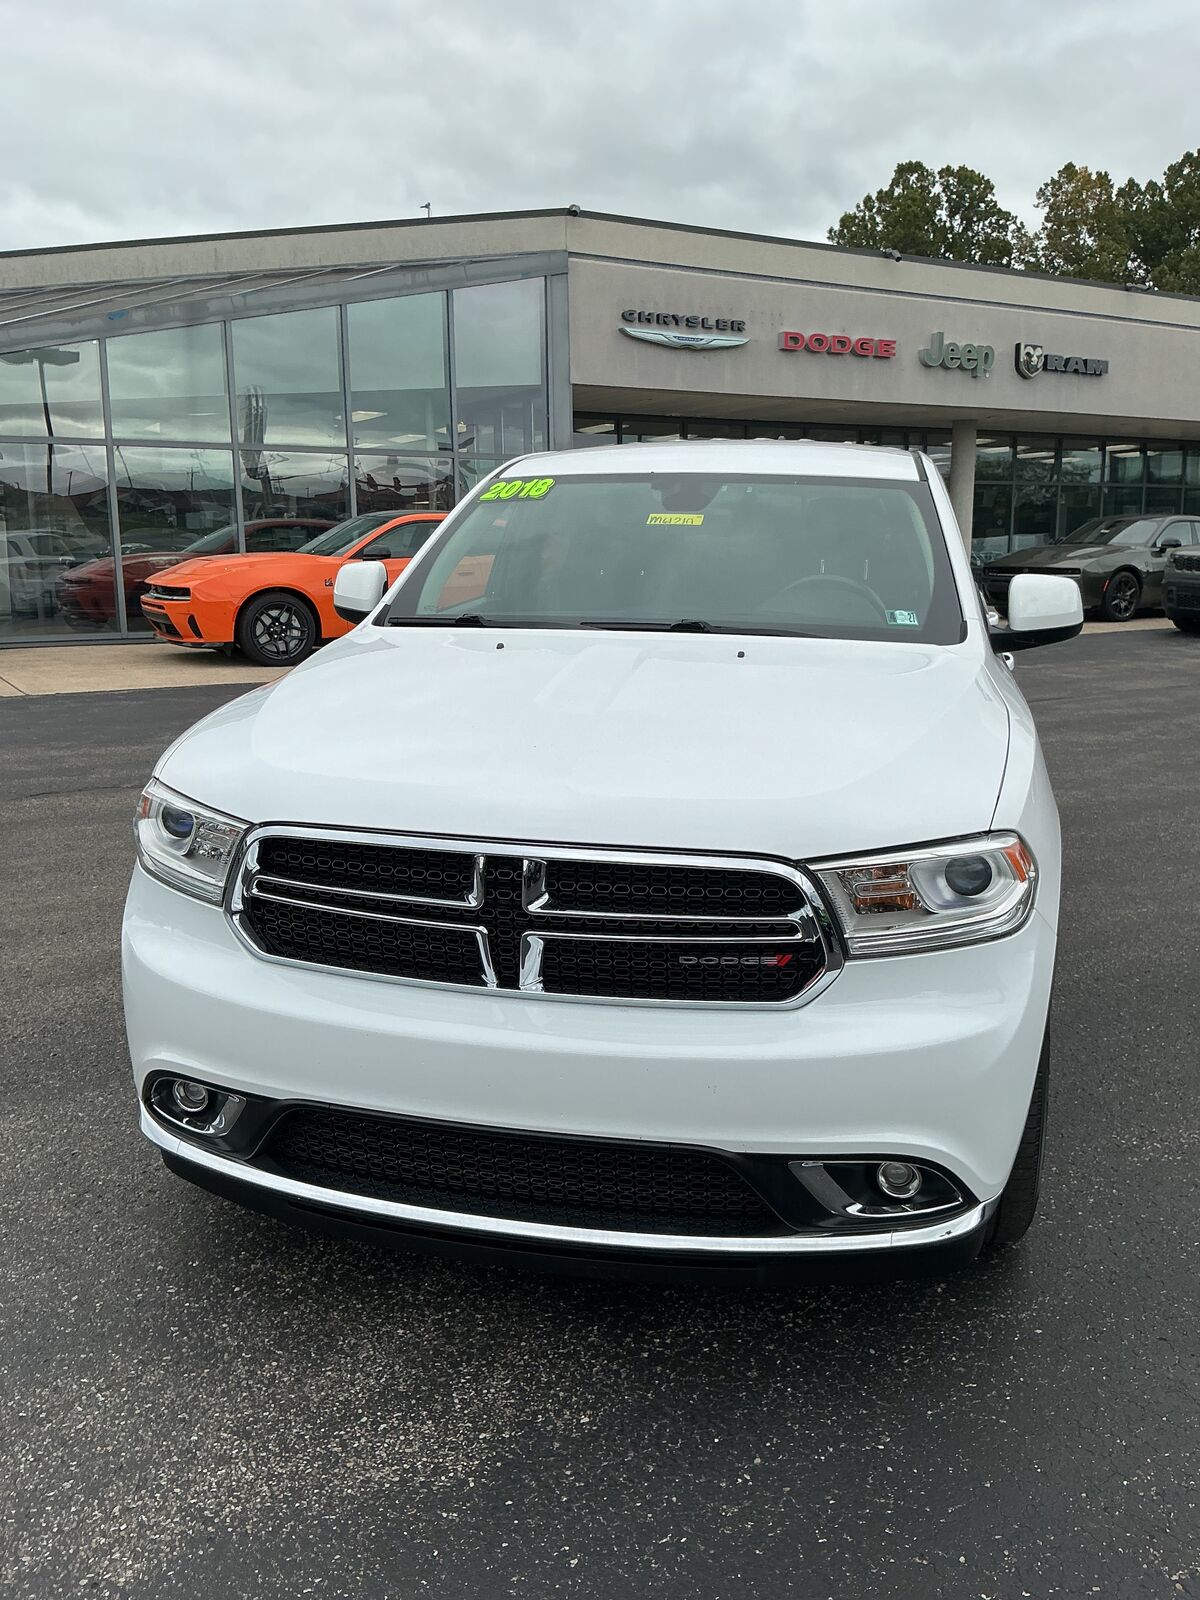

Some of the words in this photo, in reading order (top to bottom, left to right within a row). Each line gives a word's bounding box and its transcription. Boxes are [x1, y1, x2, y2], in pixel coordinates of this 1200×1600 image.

[621, 309, 746, 332] CHRYSLER
[778, 331, 897, 358] DODGE
[918, 331, 996, 378] Jeep
[1044, 353, 1109, 376] RAM
[479, 478, 555, 501] 2018
[679, 956, 778, 965] DODGE
